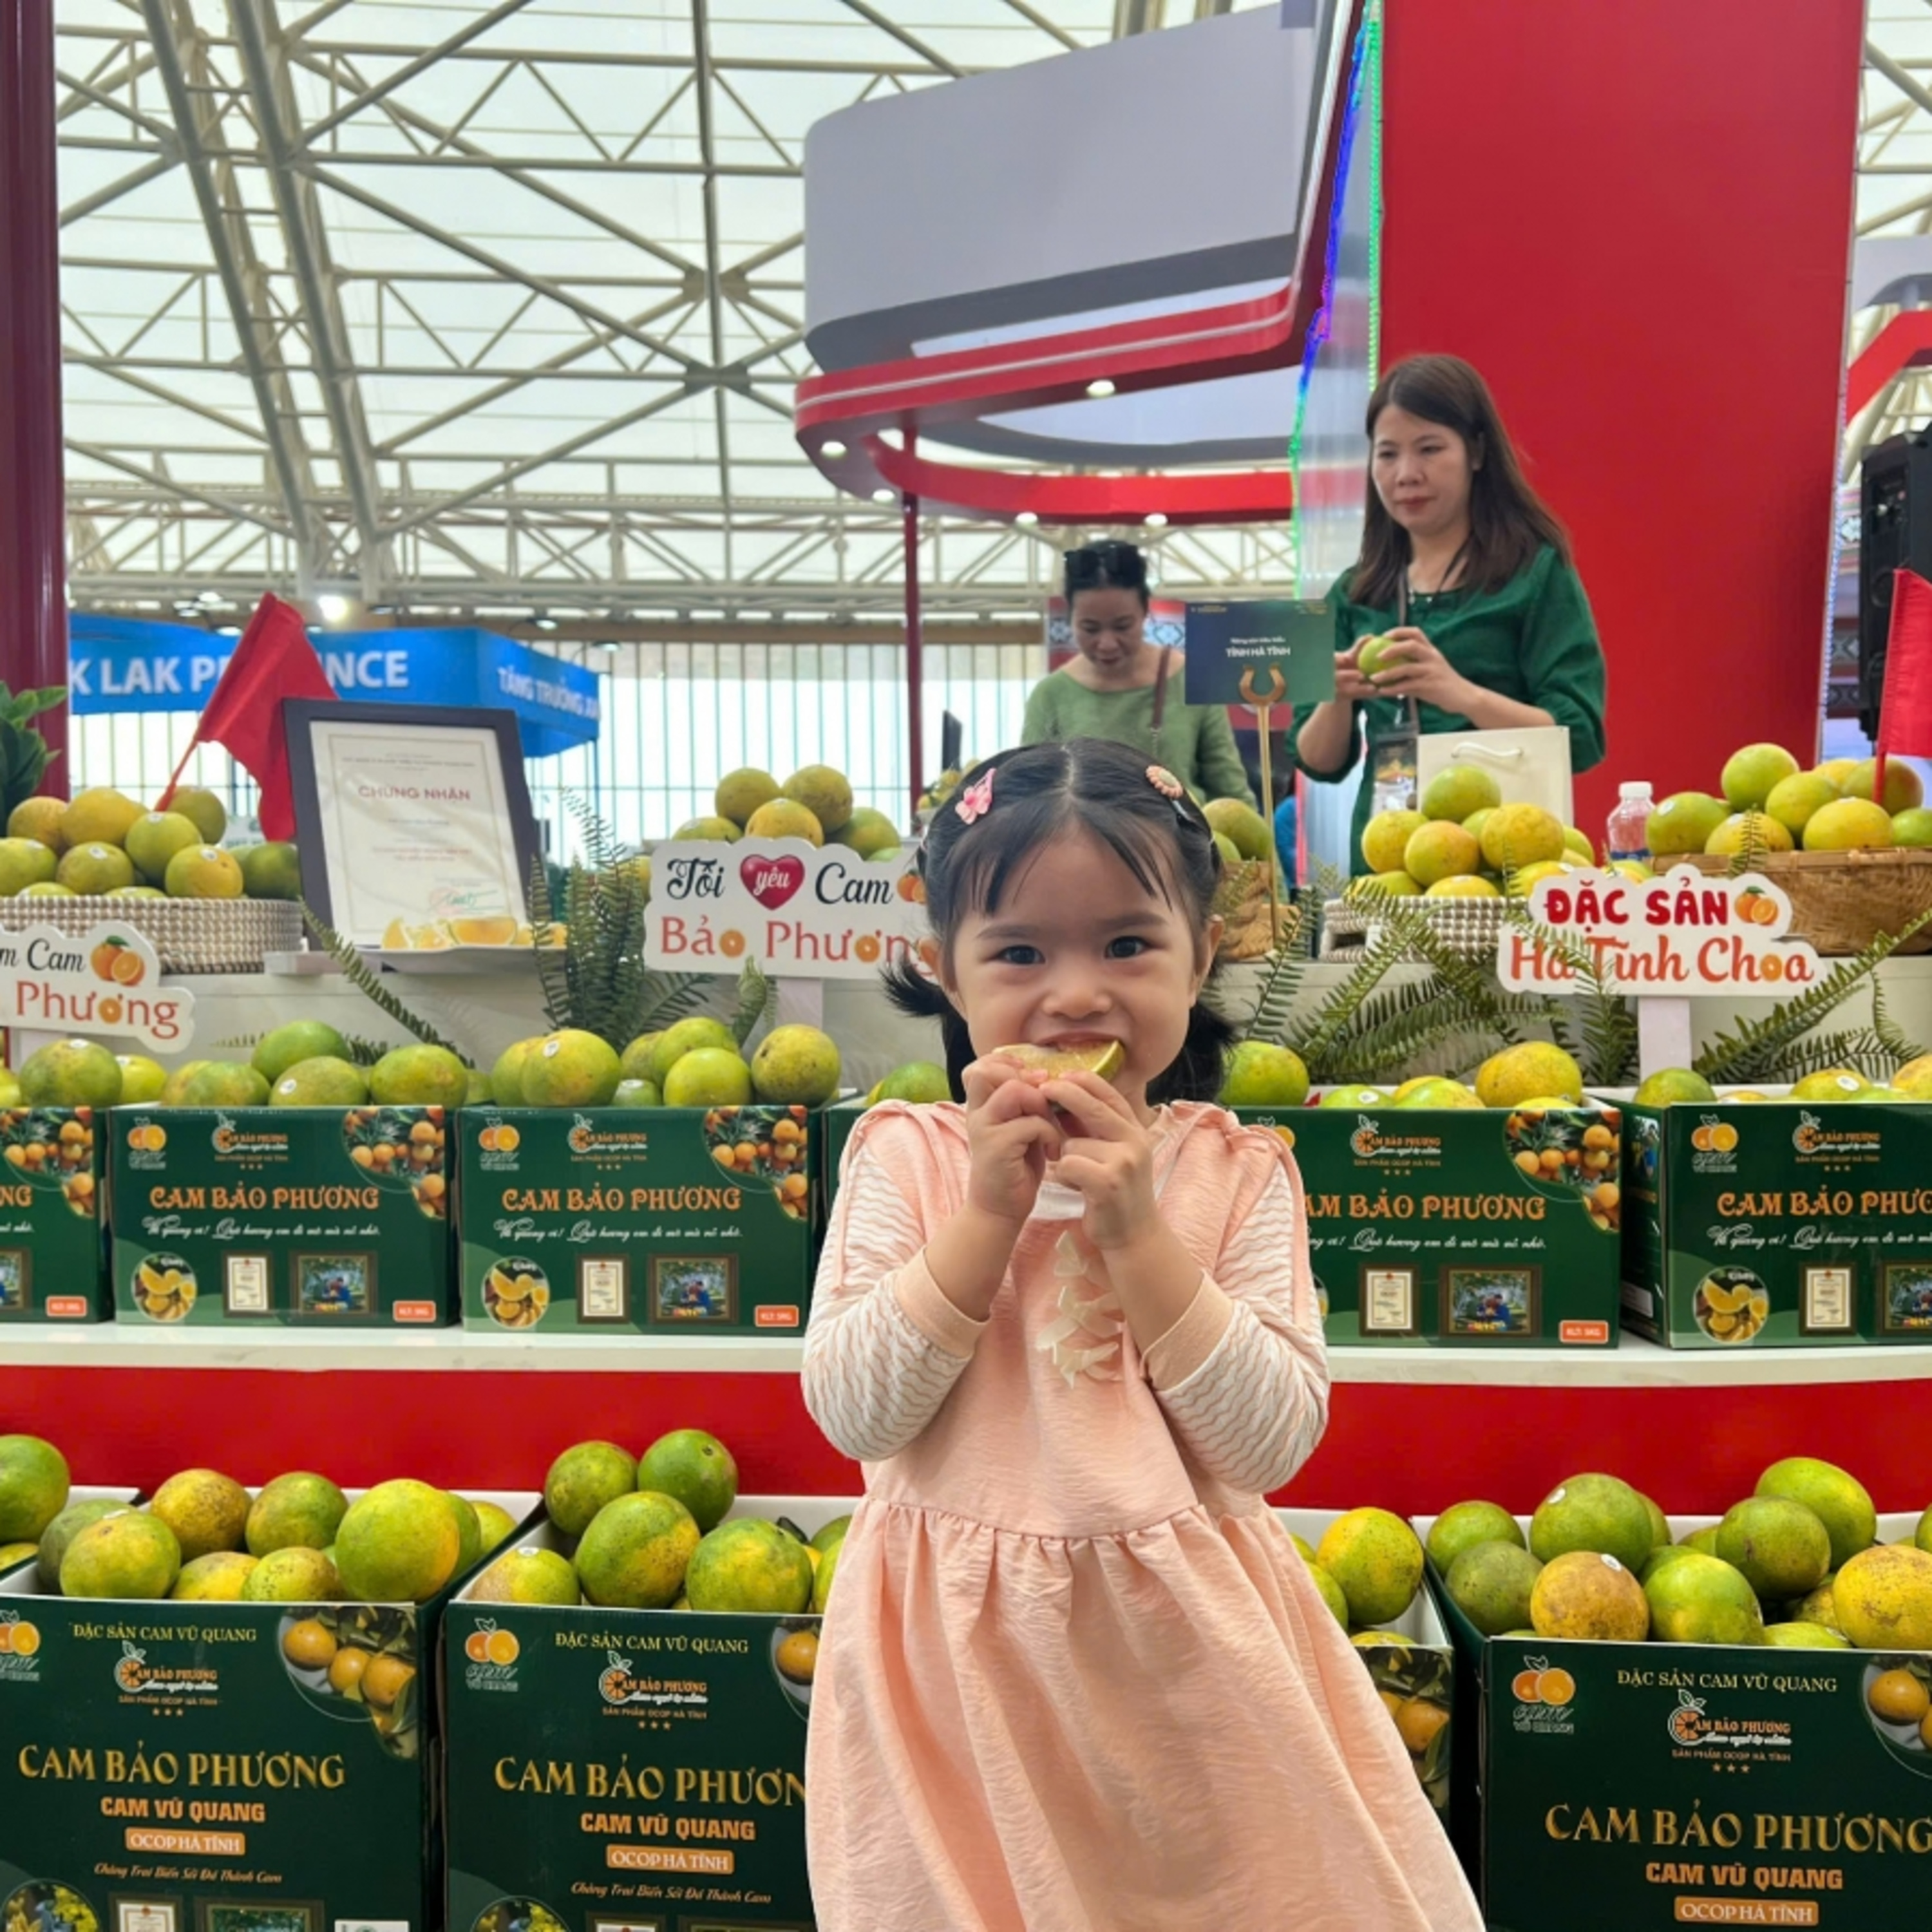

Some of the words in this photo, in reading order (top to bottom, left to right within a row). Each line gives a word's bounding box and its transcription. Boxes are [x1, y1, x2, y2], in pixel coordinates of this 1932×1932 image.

[100, 656, 183, 695] LAK
[753, 867, 791, 896] yêu
[815, 862, 894, 905] Cam
[1543, 879, 1629, 933] ĐẶC
[1645, 876, 1728, 926] SẢN
[660, 914, 746, 958] Bảo
[27, 938, 86, 972] Cam
[17, 980, 180, 1039] Phương
[149, 1187, 205, 1210] CAM
[211, 1180, 267, 1210] BẢO
[272, 1184, 379, 1210] PHƯƠNG
[501, 1188, 561, 1212] CAM
[566, 1182, 625, 1211] BẢO
[631, 1184, 742, 1211] PHƯƠNG
[1305, 1194, 1341, 1218] AM
[1349, 1188, 1414, 1219] BẢO
[1421, 1192, 1546, 1220] PHƯƠNG
[1716, 1192, 1783, 1216] CAM
[1790, 1184, 1854, 1216] BẢO
[73, 1622, 103, 1643] ĐẶC
[107, 1621, 137, 1640] SẢN
[140, 1626, 175, 1642] CAM
[177, 1624, 200, 1642] VŨ
[202, 1627, 256, 1645] QUANG
[554, 1630, 587, 1649] ĐẶC
[591, 1630, 623, 1649] SẢN
[625, 1634, 661, 1650] CAM
[665, 1633, 688, 1651] VŨ
[691, 1636, 748, 1655] QUANG
[1616, 1667, 1654, 1689] ĐẶC
[1658, 1667, 1694, 1687] SẢN
[1698, 1672, 1740, 1689] CAM
[1742, 1671, 1770, 1690] VŨ
[1773, 1675, 1837, 1694] QUANG
[1714, 1717, 1739, 1732] BẢO
[1741, 1720, 1792, 1734] PHƯƠNG
[18, 1745, 96, 1781] CAM
[105, 1740, 179, 1785] BẢO
[189, 1751, 346, 1789] PHƯƠNG
[495, 1757, 576, 1795] CAM
[586, 1754, 665, 1800] BẢO
[675, 1768, 806, 1806] PHƯƠN
[100, 1797, 148, 1817] CAM
[154, 1795, 183, 1819] VŨ
[189, 1801, 266, 1823] QUANG
[580, 1812, 632, 1833] CAM
[638, 1814, 667, 1835] VŨ
[675, 1817, 756, 1841] QUANG
[1546, 1804, 1640, 1844] CAM
[1653, 1799, 1743, 1849] BẢO
[1754, 1812, 1932, 1854] PHƯƠNG
[130, 1834, 176, 1850] OCOP
[180, 1833, 201, 1850] HÀ
[203, 1834, 240, 1852] TĨNH
[611, 1851, 661, 1867] OCOP
[663, 1852, 687, 1868] HÀ
[688, 1853, 729, 1870] TĨNH
[611, 1884, 636, 1896] Trai
[1645, 1862, 1704, 1885] CAM
[1713, 1861, 1746, 1888] VŨ
[1754, 1868, 1843, 1892] QUANG
[1681, 1903, 1738, 1920] OCOP
[1739, 1902, 1766, 1921] HÀ
[1768, 1904, 1813, 1923] TĨNH
